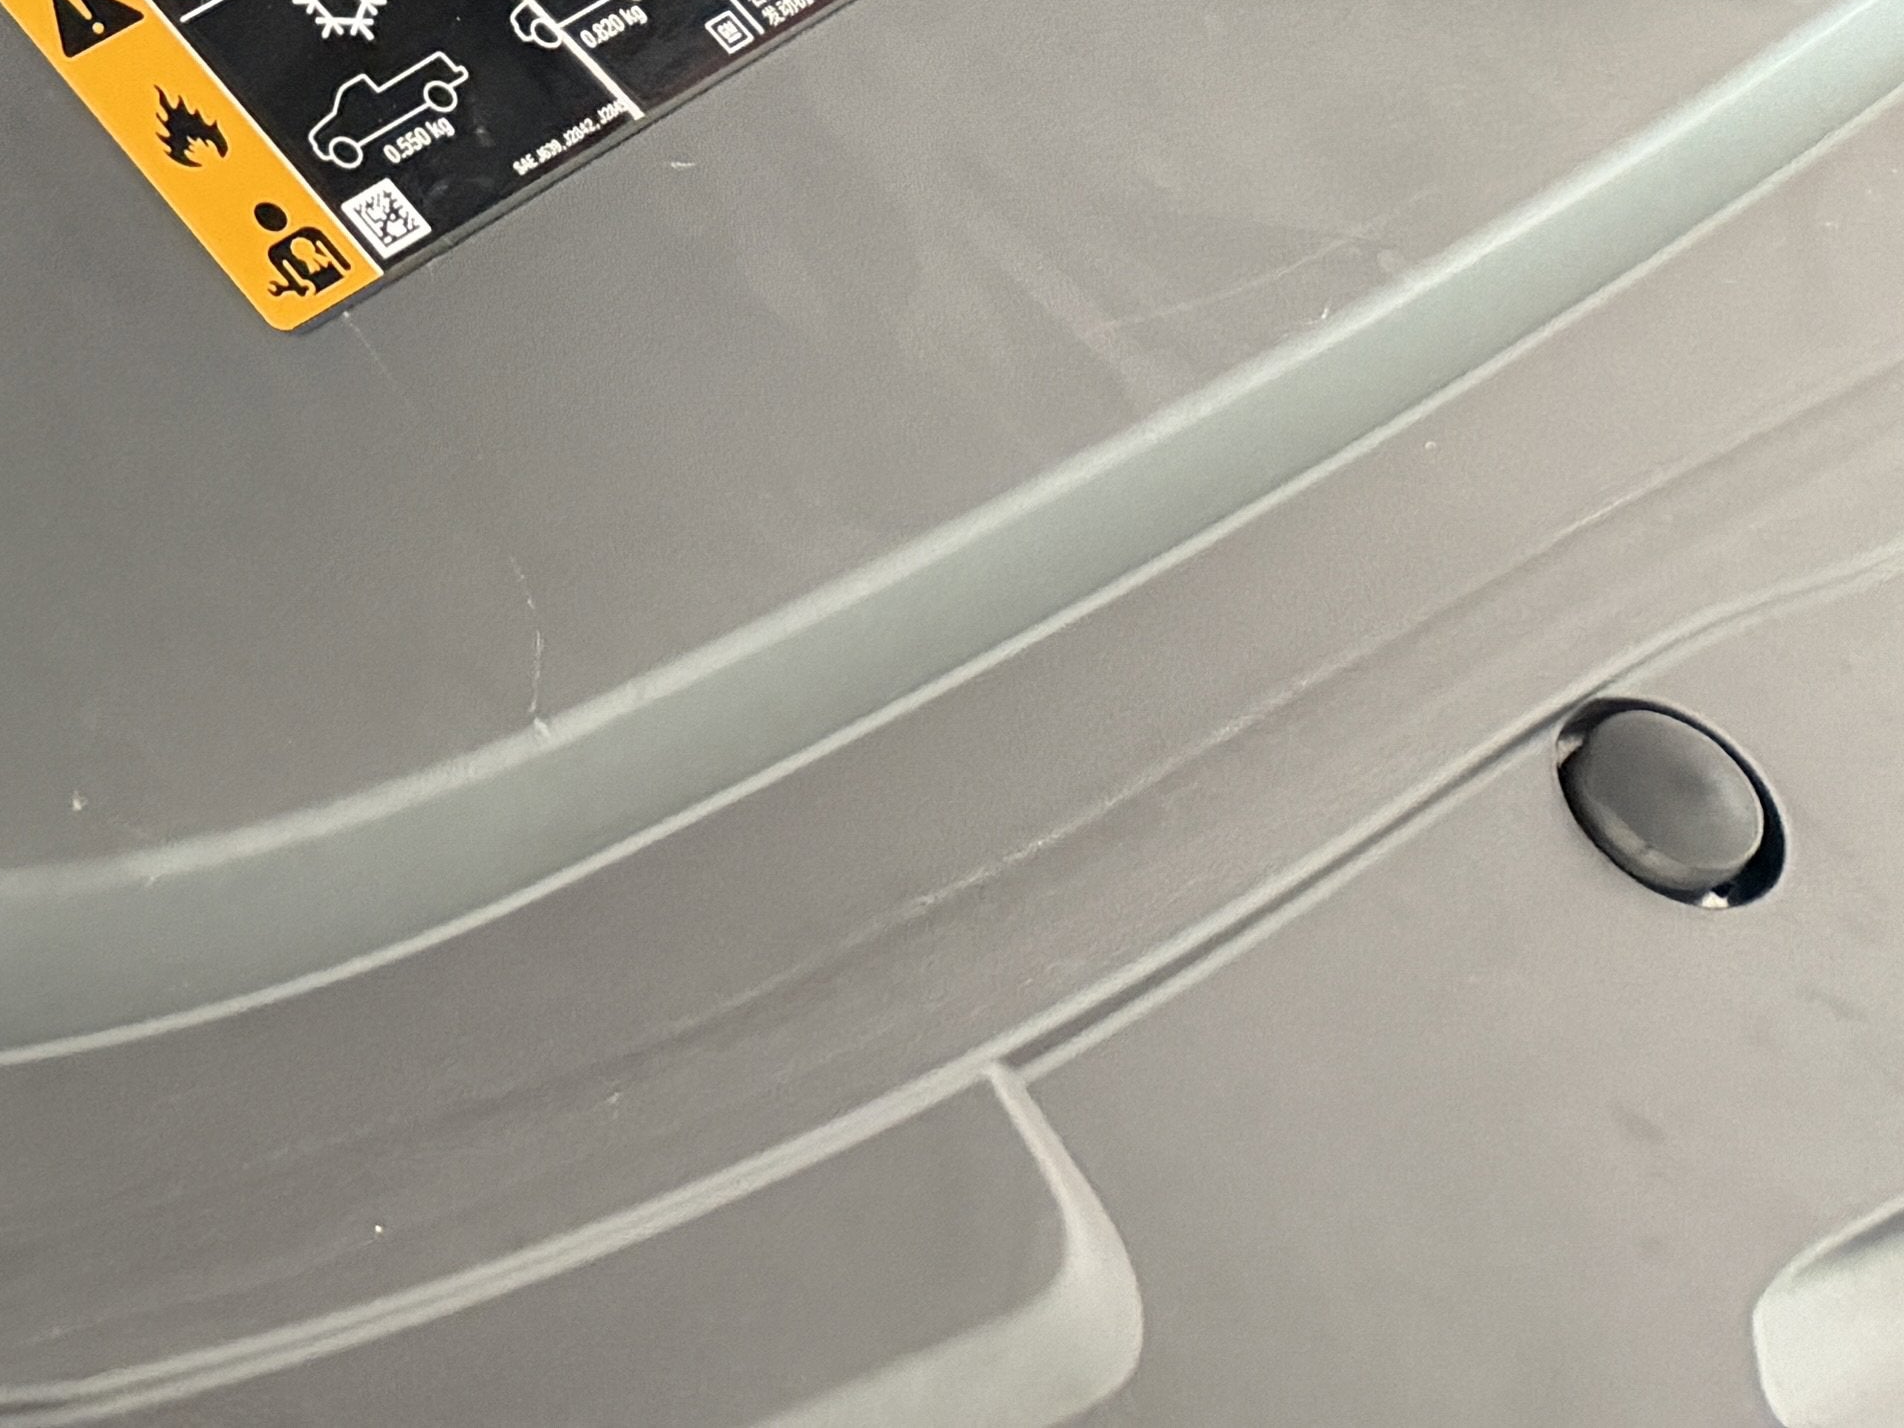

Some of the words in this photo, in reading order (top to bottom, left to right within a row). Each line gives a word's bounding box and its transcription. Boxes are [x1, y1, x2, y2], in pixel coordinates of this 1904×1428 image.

[579, 13, 625, 48] 0.820
[618, 0, 648, 26] kg
[383, 126, 431, 163] 0.550
[424, 117, 455, 139] kg
[512, 153, 539, 175] SAE
